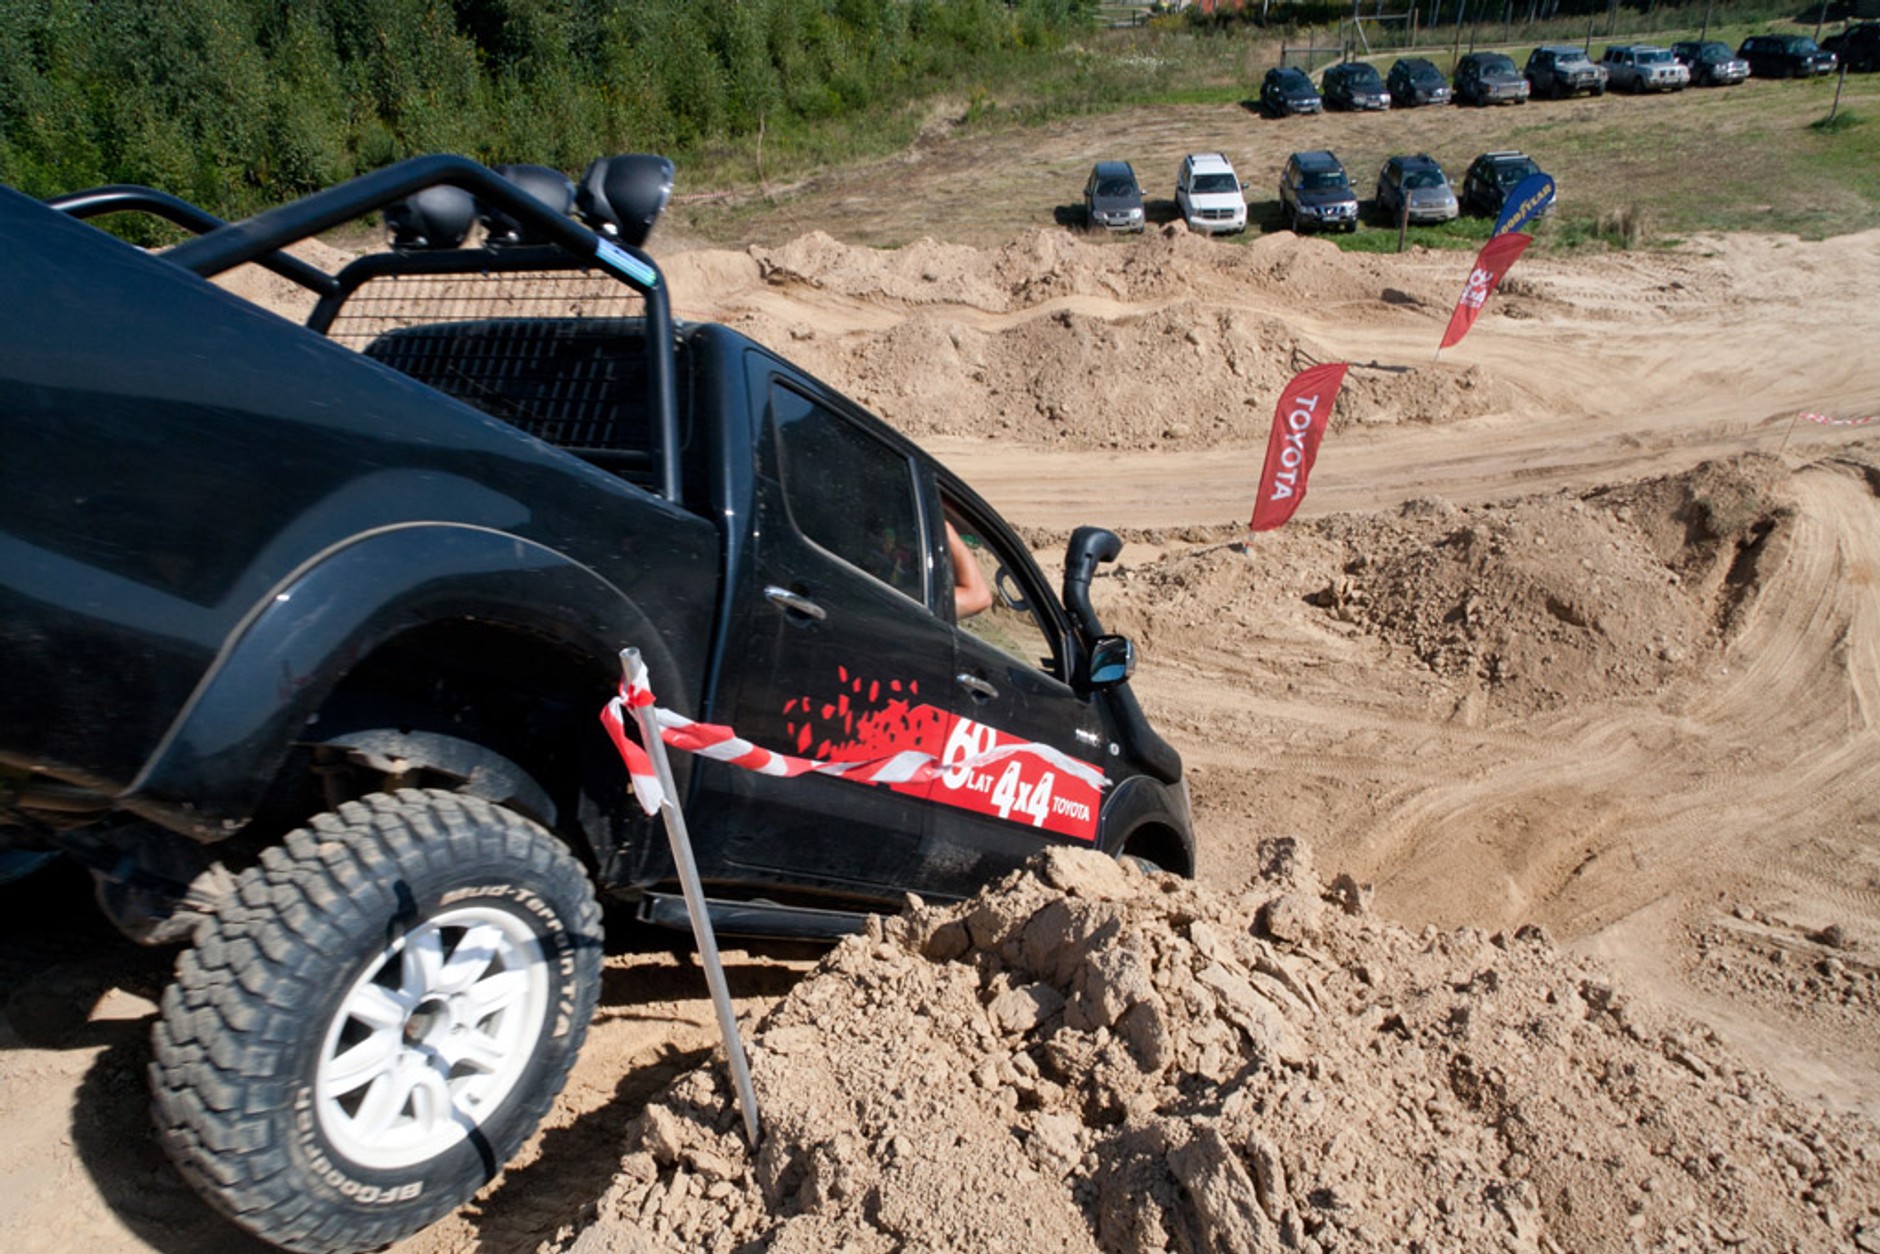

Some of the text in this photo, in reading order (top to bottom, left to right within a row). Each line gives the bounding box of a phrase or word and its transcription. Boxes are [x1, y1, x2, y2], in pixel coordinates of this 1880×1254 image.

[1495, 183, 1552, 236] OODYEAR
[1270, 395, 1319, 501] TOYOTA
[966, 769, 995, 793] LAT
[990, 760, 1055, 828] 4x4
[1052, 795, 1091, 822] TOYOTA
